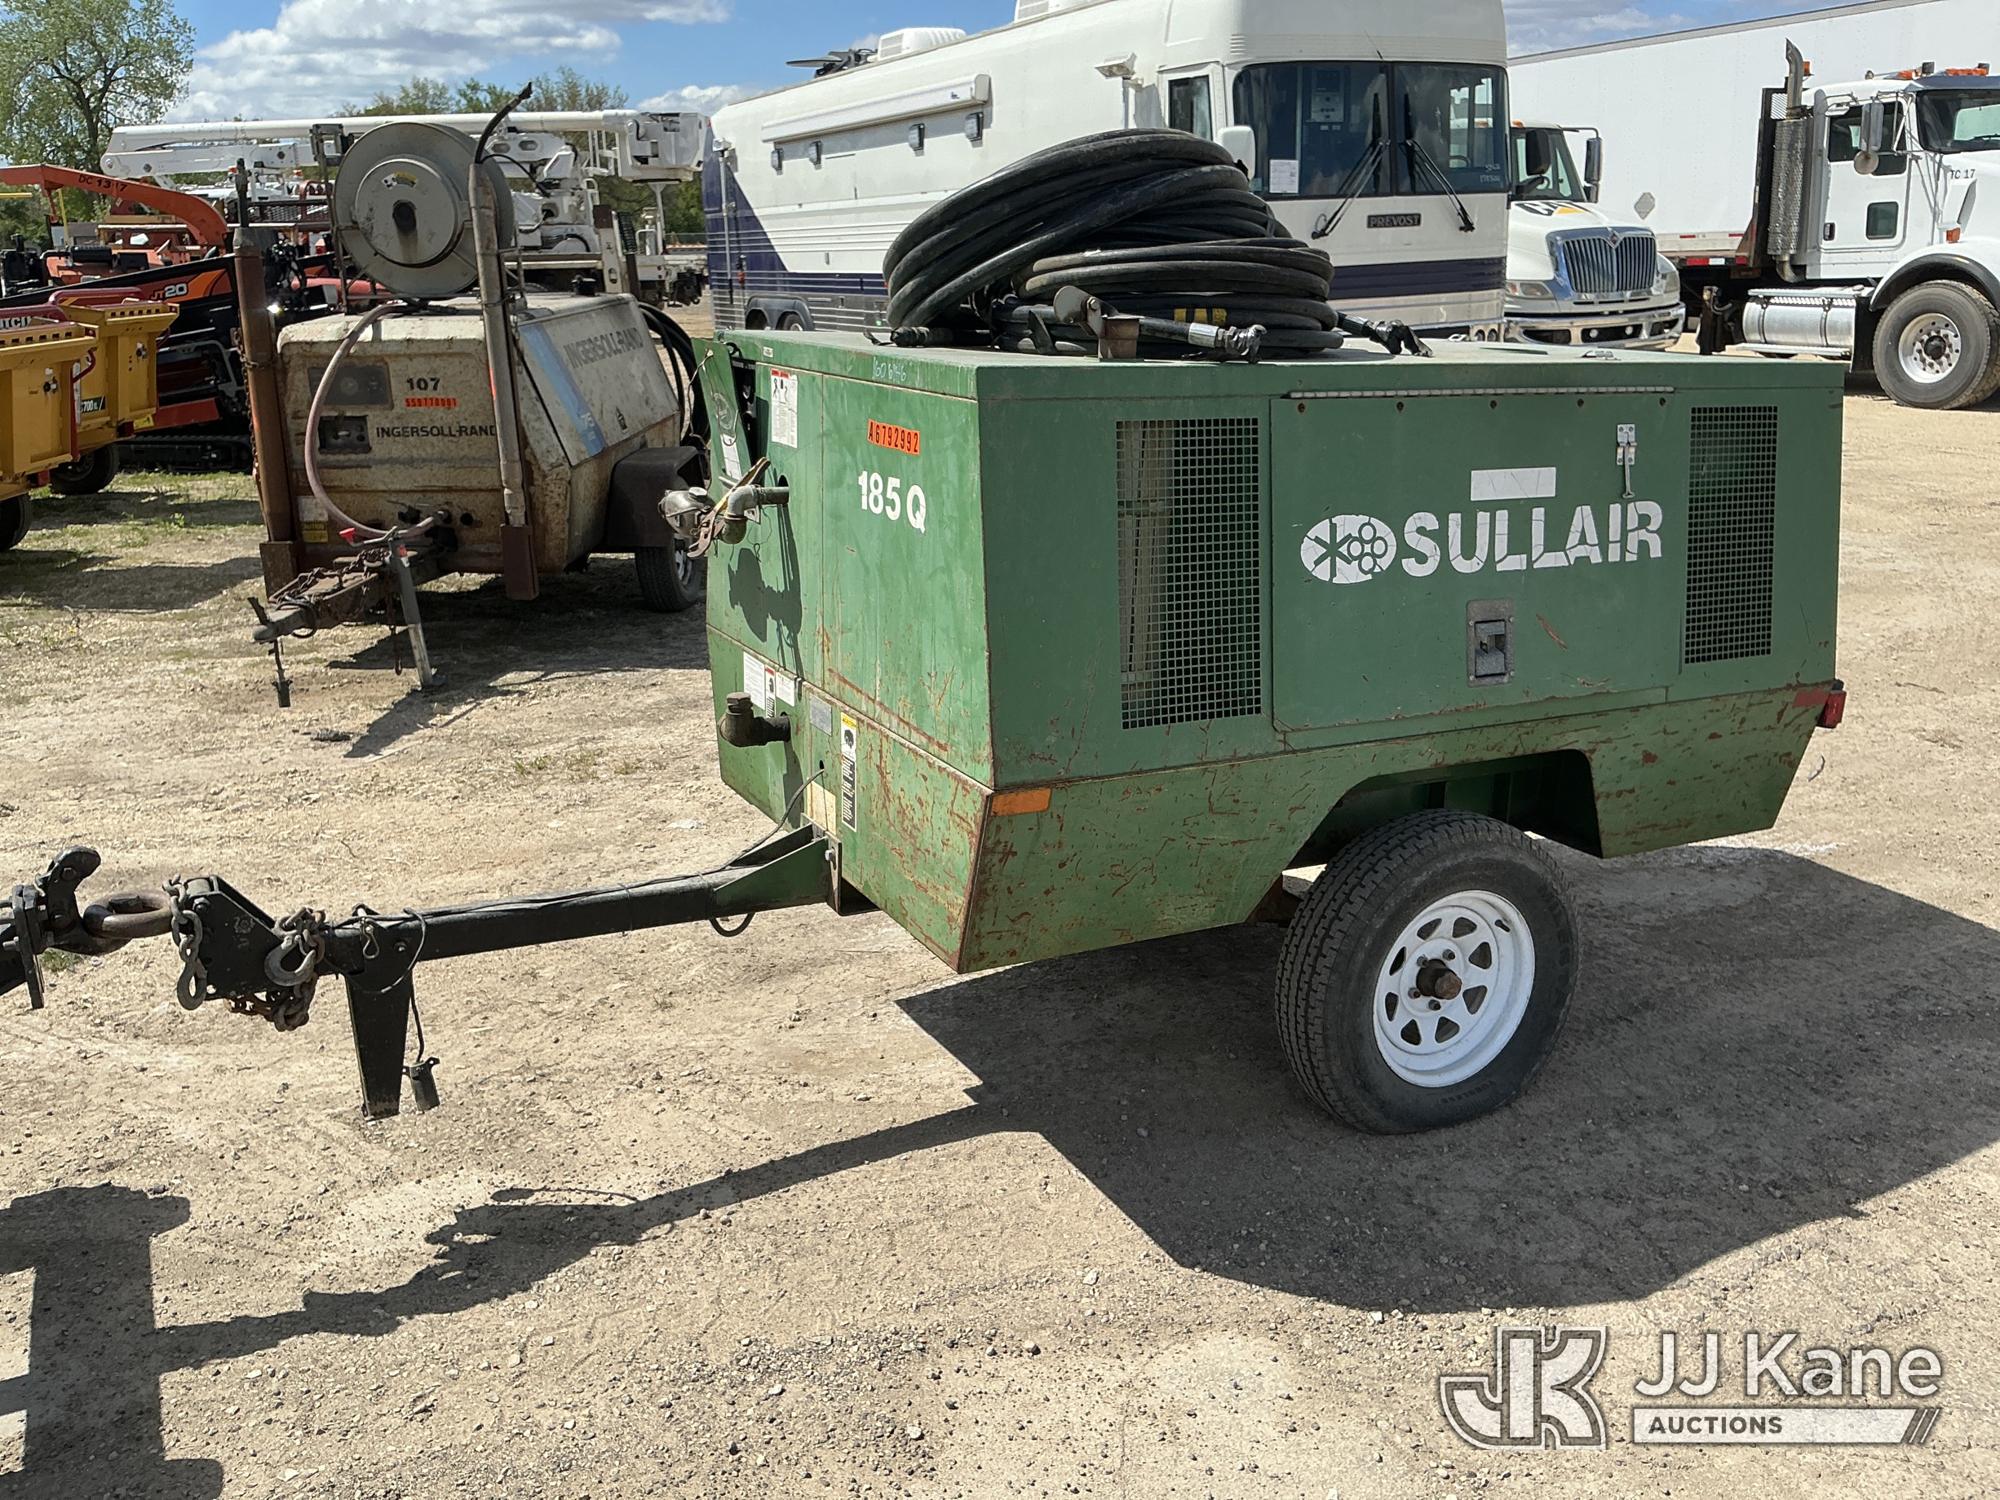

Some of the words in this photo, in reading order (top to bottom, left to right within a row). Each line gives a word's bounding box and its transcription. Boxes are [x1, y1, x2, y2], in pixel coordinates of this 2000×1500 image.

[1370, 214, 1420, 227] PREVOST
[406, 377, 441, 391] 107
[867, 420, 920, 454] A6792992
[1401, 500, 1663, 577] SULLAIR
